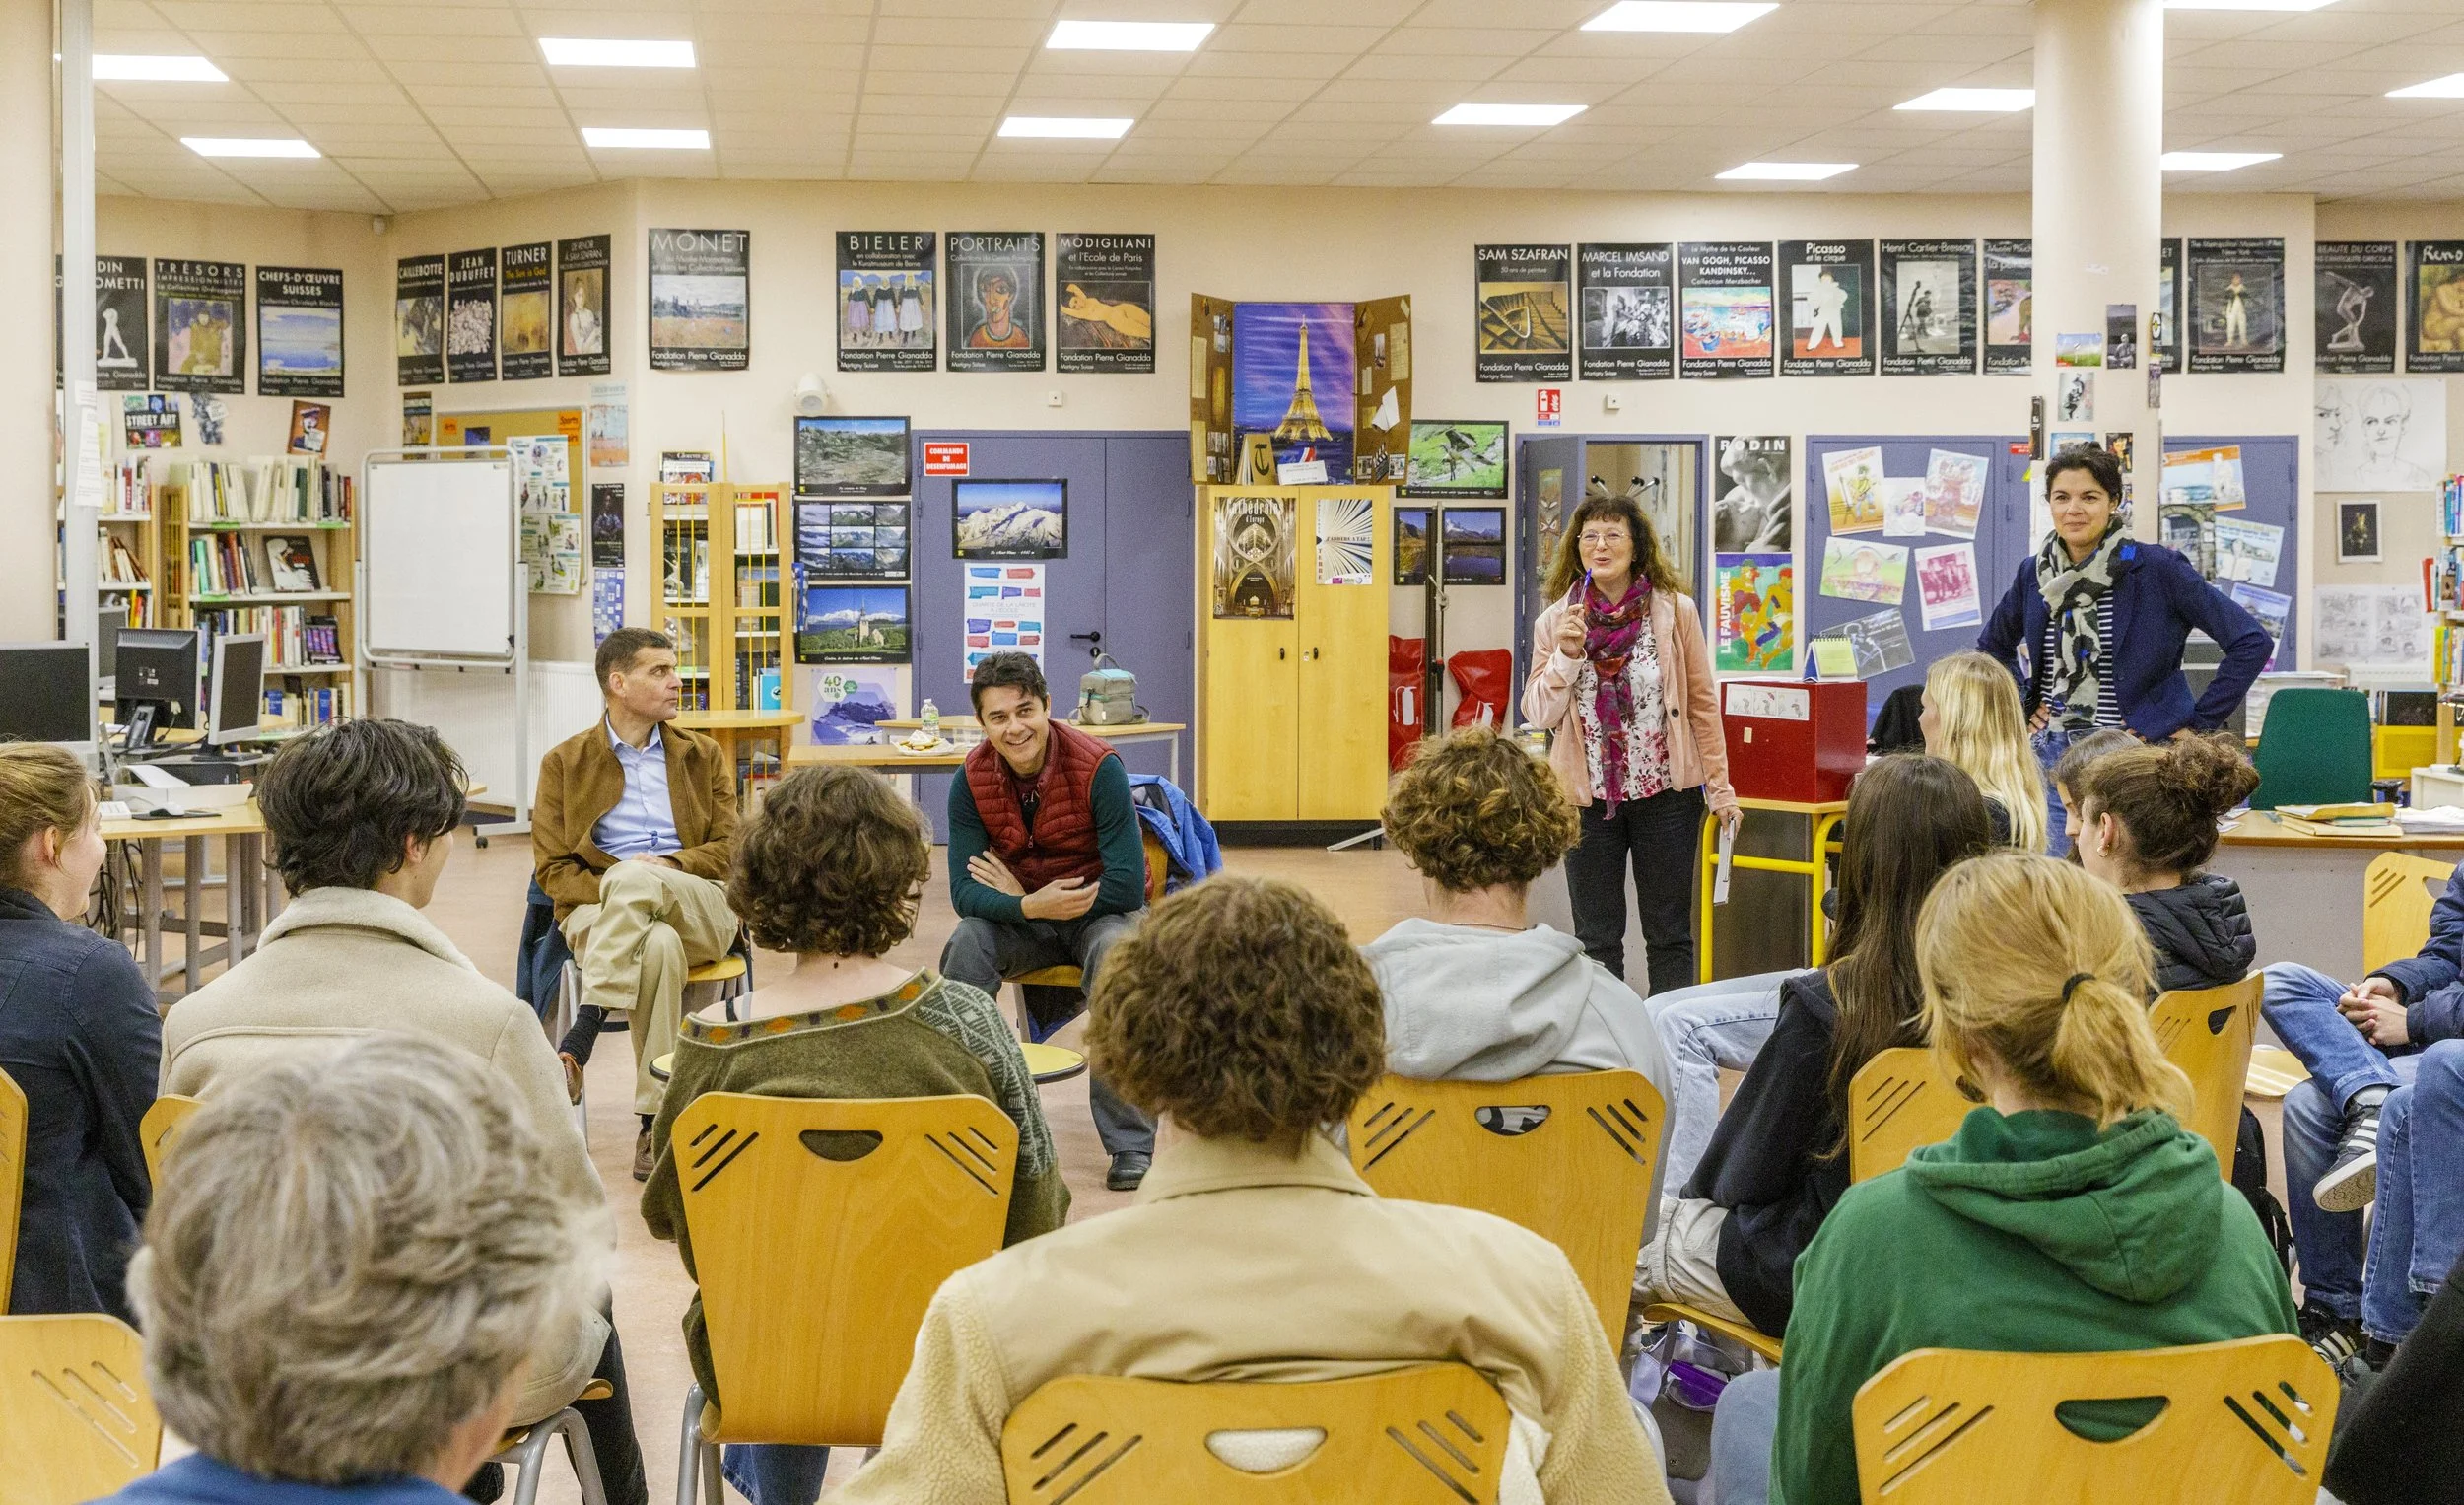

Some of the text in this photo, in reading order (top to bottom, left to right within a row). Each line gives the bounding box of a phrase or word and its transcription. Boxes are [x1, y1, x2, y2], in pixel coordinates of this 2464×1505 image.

[651, 233, 747, 253] MONET
[850, 236, 923, 250] BIELER
[950, 237, 1041, 252] PORTRAITS
[1060, 237, 1151, 248] MODIGLIANI
[1806, 242, 1846, 254] Picasso
[1882, 243, 1906, 253] Henri
[506, 247, 546, 266] TURNER
[1079, 252, 1106, 262] l'Ecole
[1109, 252, 1120, 262] de
[1124, 252, 1143, 262] Paris
[1478, 248, 1569, 260] SAM SZAFRAN
[1581, 250, 1669, 262] MARCEL IMSAND
[1823, 254, 1846, 263] cirque
[2423, 245, 2464, 262] Reno
[460, 256, 484, 268] JEAN
[1681, 256, 1700, 265] VAN
[1702, 256, 1733, 266] GOGH,
[158, 261, 243, 279] TRÉSORS
[398, 263, 443, 279] CAILLEBOTTE
[450, 267, 495, 283] DUBUFFET
[1591, 267, 1660, 278] et la Fondation
[1699, 266, 1756, 276] KANDINSKY...
[258, 271, 341, 285] CHEFS-D'ŒUVRE
[282, 284, 322, 296] SUISSES
[688, 351, 708, 360] Pierre
[710, 351, 745, 360] Gianadda
[1060, 353, 1093, 362] Fondation
[1987, 357, 2019, 366] Fondation
[2192, 355, 2224, 364] Fondation
[2245, 355, 2281, 364] Gianadda
[1479, 363, 1512, 372] Fondation
[1583, 360, 1614, 369] Fondation
[126, 413, 177, 427] STREET ART
[1720, 439, 1786, 451] RODIN
[1226, 498, 1284, 515] Cathédrales
[1246, 515, 1266, 524] d'Europe
[1720, 571, 1731, 654] LE FAUVISME
[824, 676, 842, 686] 40
